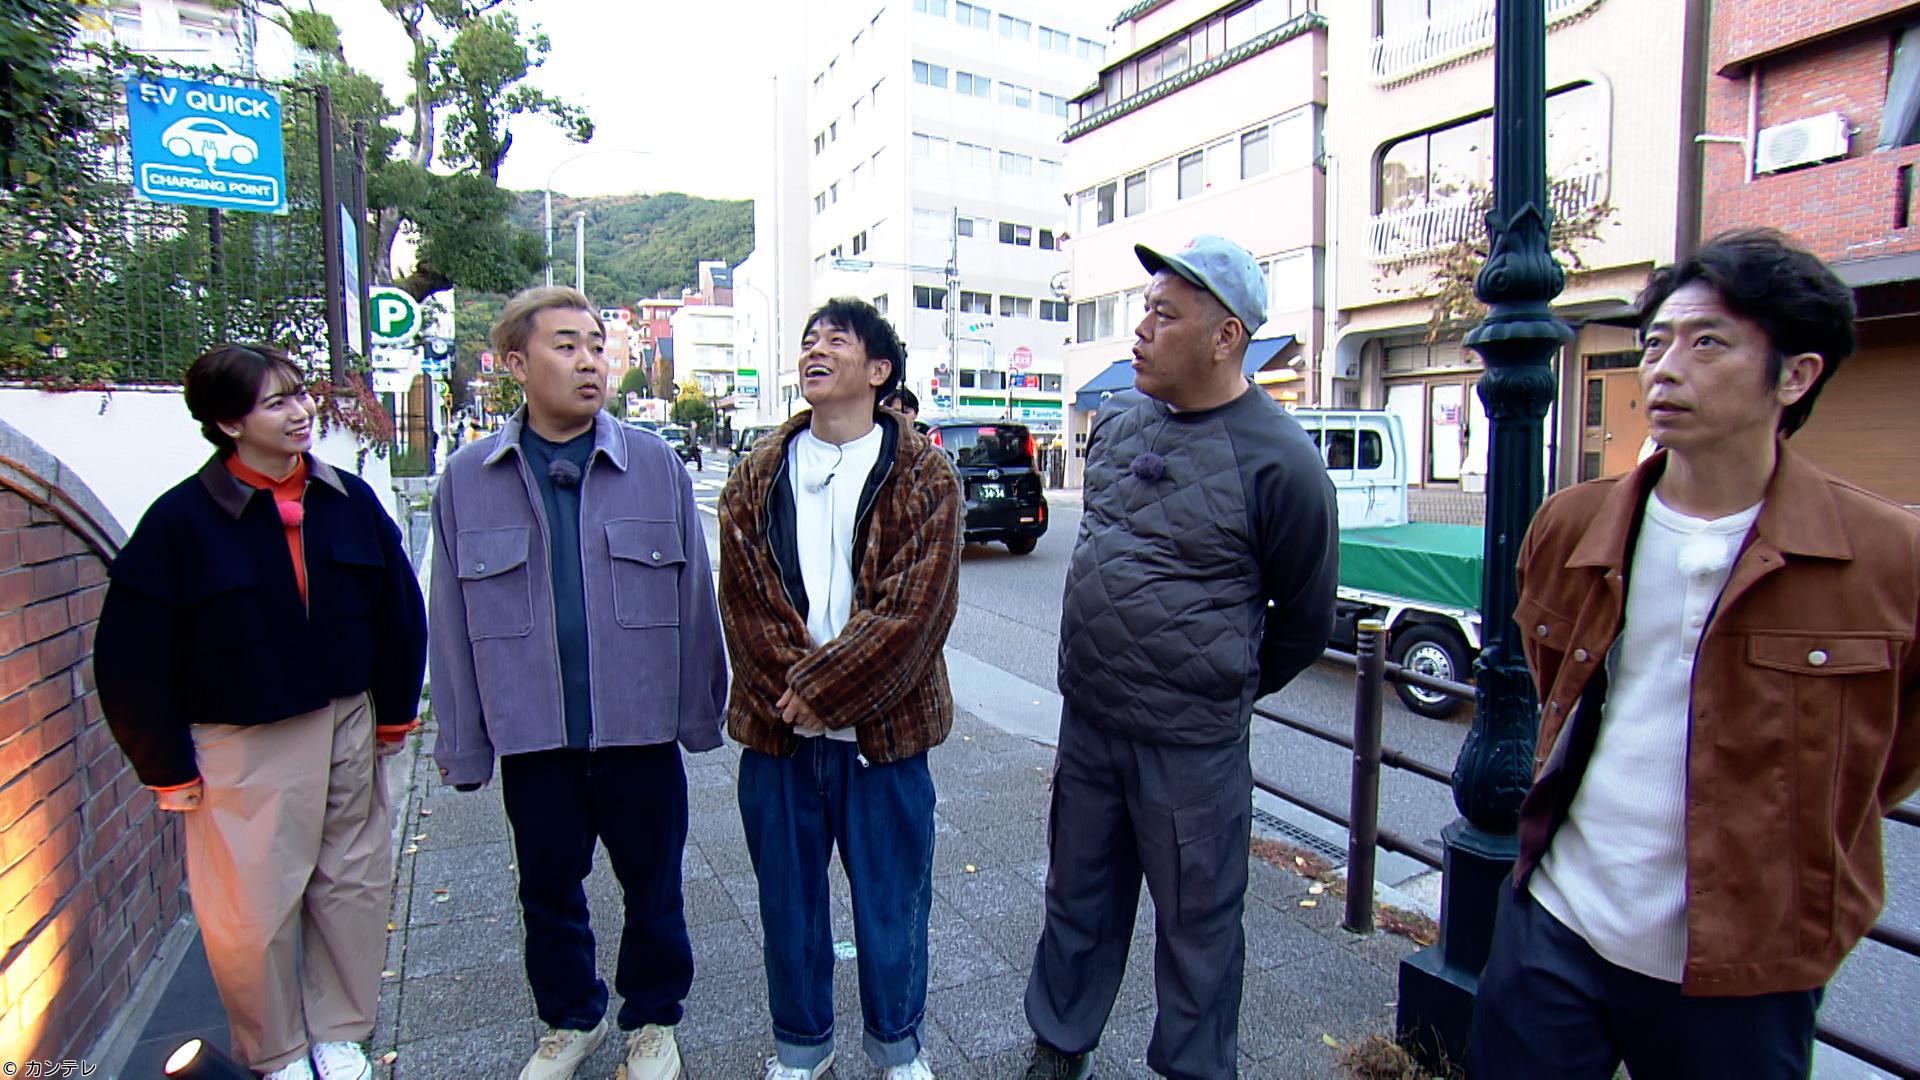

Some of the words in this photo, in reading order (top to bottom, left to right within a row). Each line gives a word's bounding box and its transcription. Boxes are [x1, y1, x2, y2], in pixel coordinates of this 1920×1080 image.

[140, 83, 177, 106] EV
[186, 90, 271, 120] QUICK
[150, 172, 226, 192] CHARGING
[229, 183, 271, 196] POINT
[378, 299, 408, 333] P
